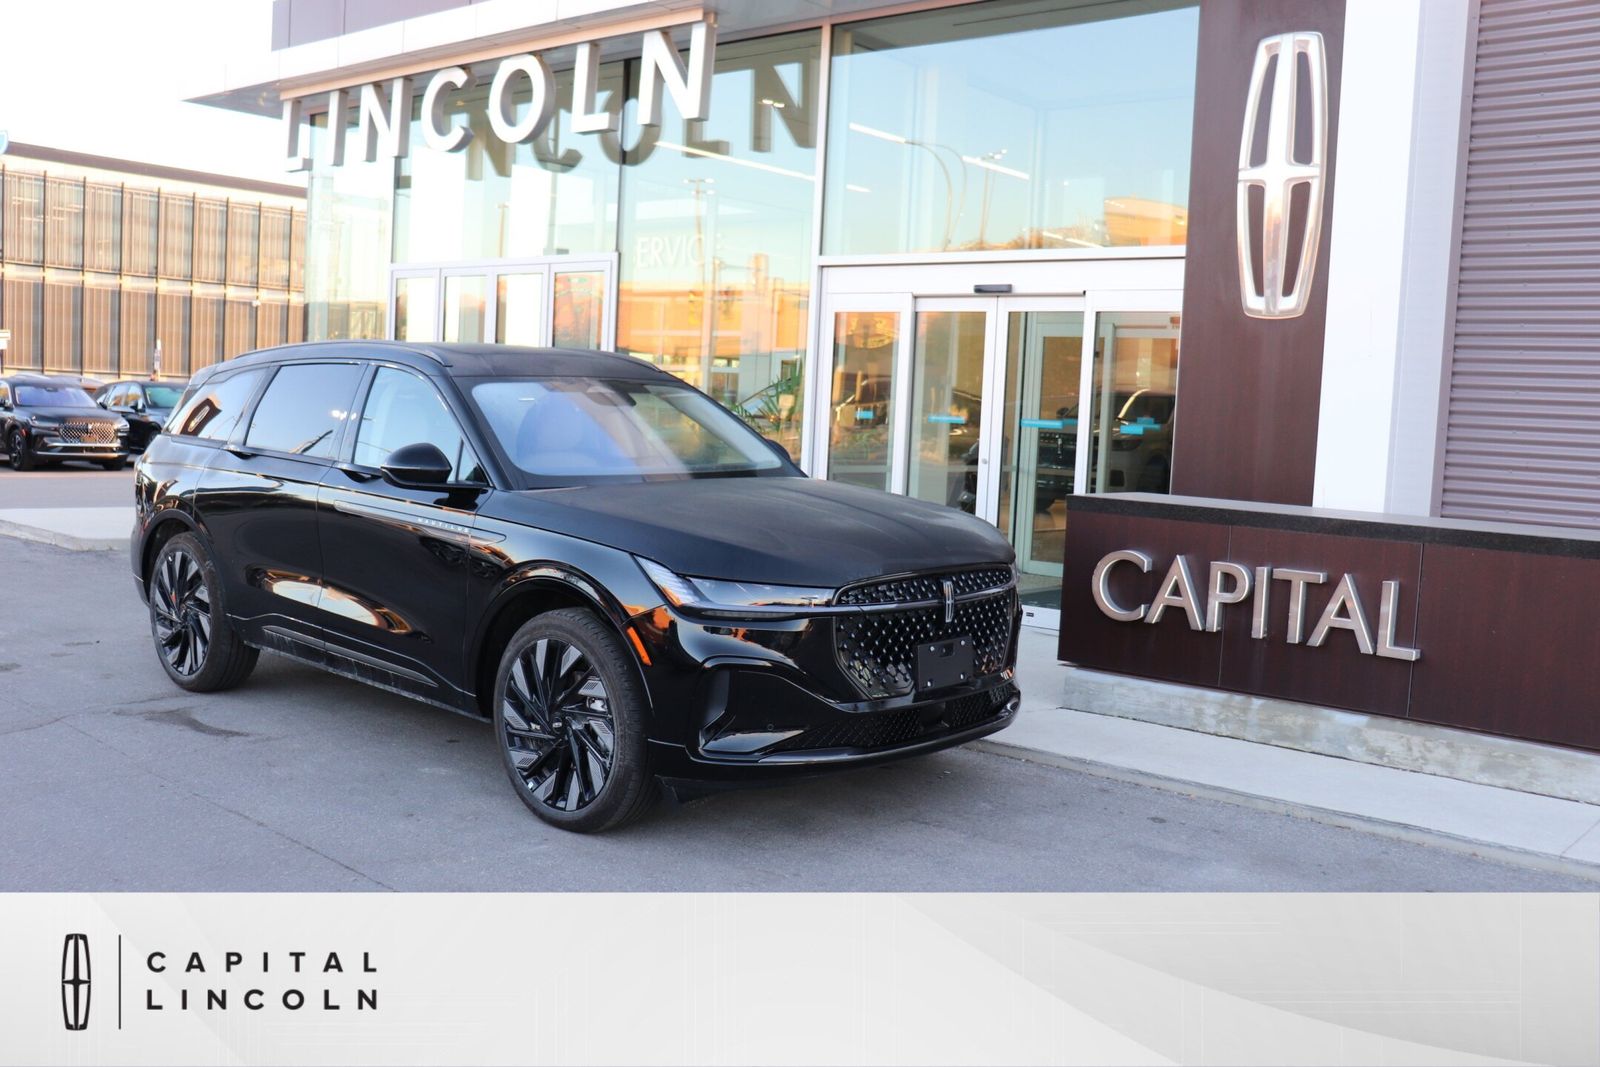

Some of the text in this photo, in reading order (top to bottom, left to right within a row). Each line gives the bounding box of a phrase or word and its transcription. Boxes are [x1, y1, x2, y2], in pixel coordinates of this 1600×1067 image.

[283, 21, 717, 173] LINCOLN
[633, 232, 723, 270] ERVIC
[417, 518, 470, 533] NAUTILUS
[1091, 549, 1421, 662] CAPITAL
